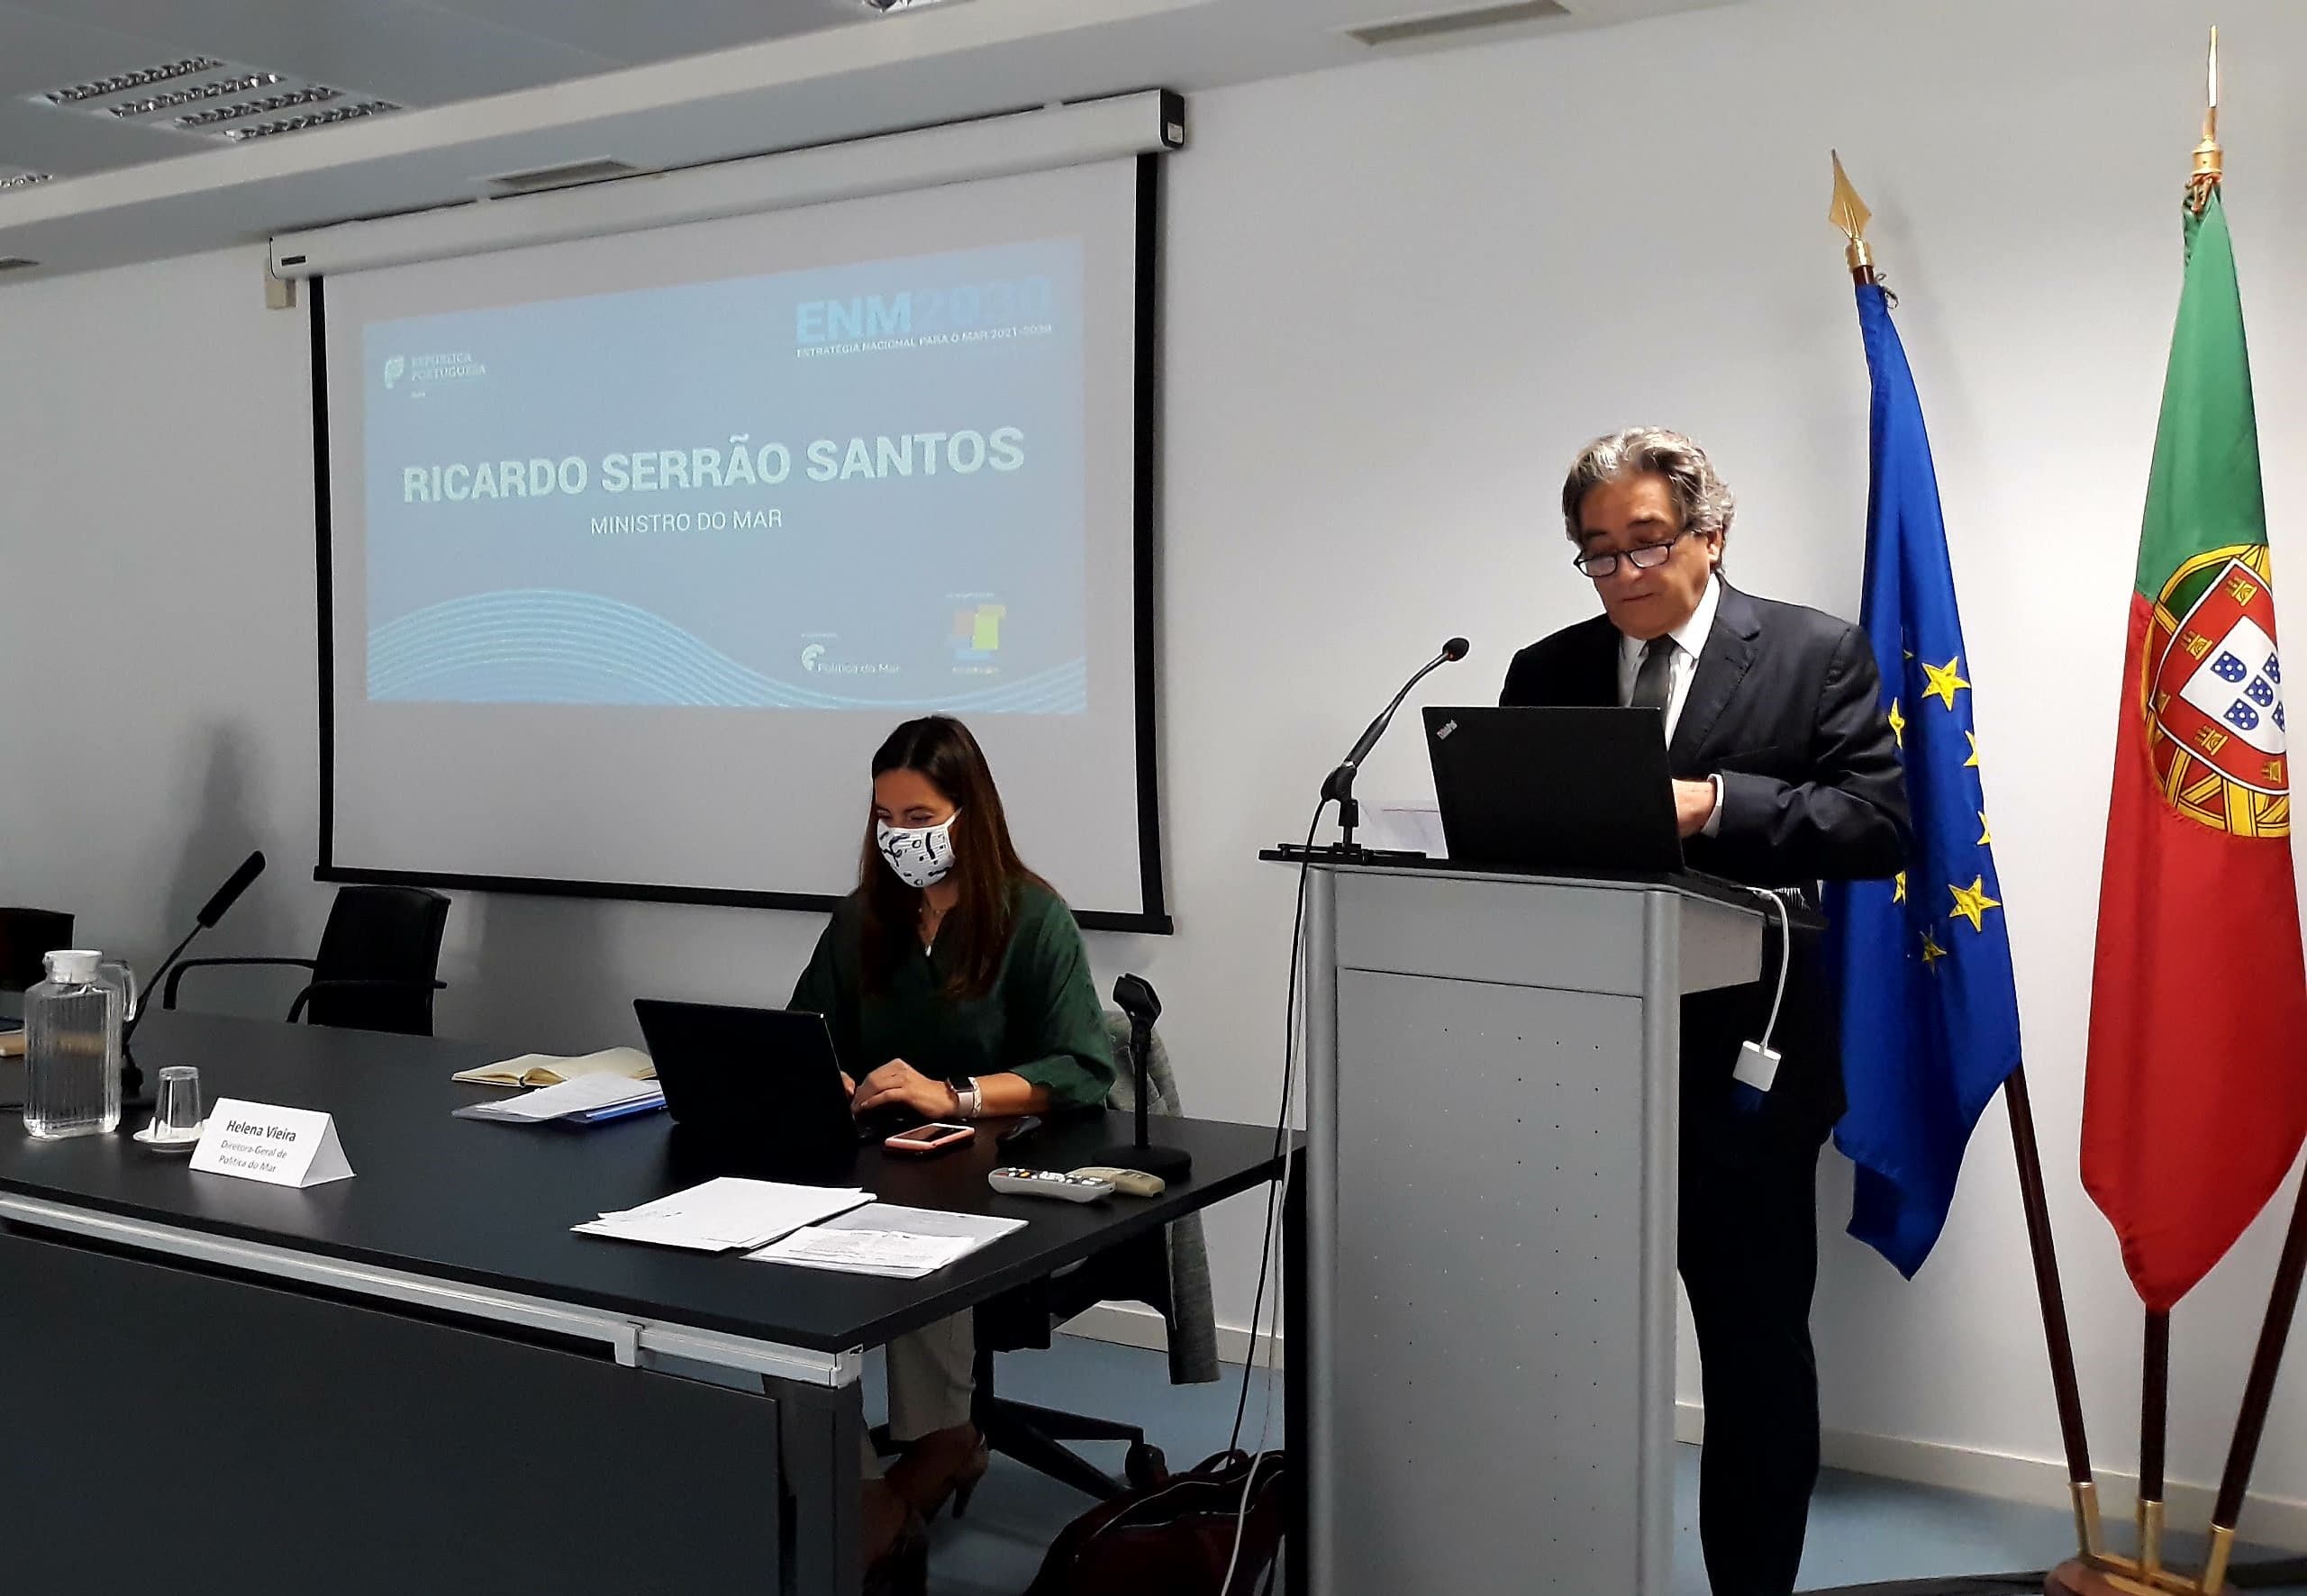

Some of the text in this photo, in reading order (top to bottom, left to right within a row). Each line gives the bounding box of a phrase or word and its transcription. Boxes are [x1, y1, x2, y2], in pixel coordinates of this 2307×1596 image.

[861, 338, 916, 352] NACIONAL
[919, 333, 947, 347] PARA
[950, 333, 959, 344] O
[961, 331, 987, 343] MAR
[404, 426, 1025, 503] RICARDO SERRÃO SANTOS
[590, 508, 783, 535] MINISTRO DO MAR
[226, 1120, 296, 1141] Helena Vieira
[221, 1139, 287, 1159] Diretora-Geral de
[218, 1156, 277, 1174] Política do Mar
